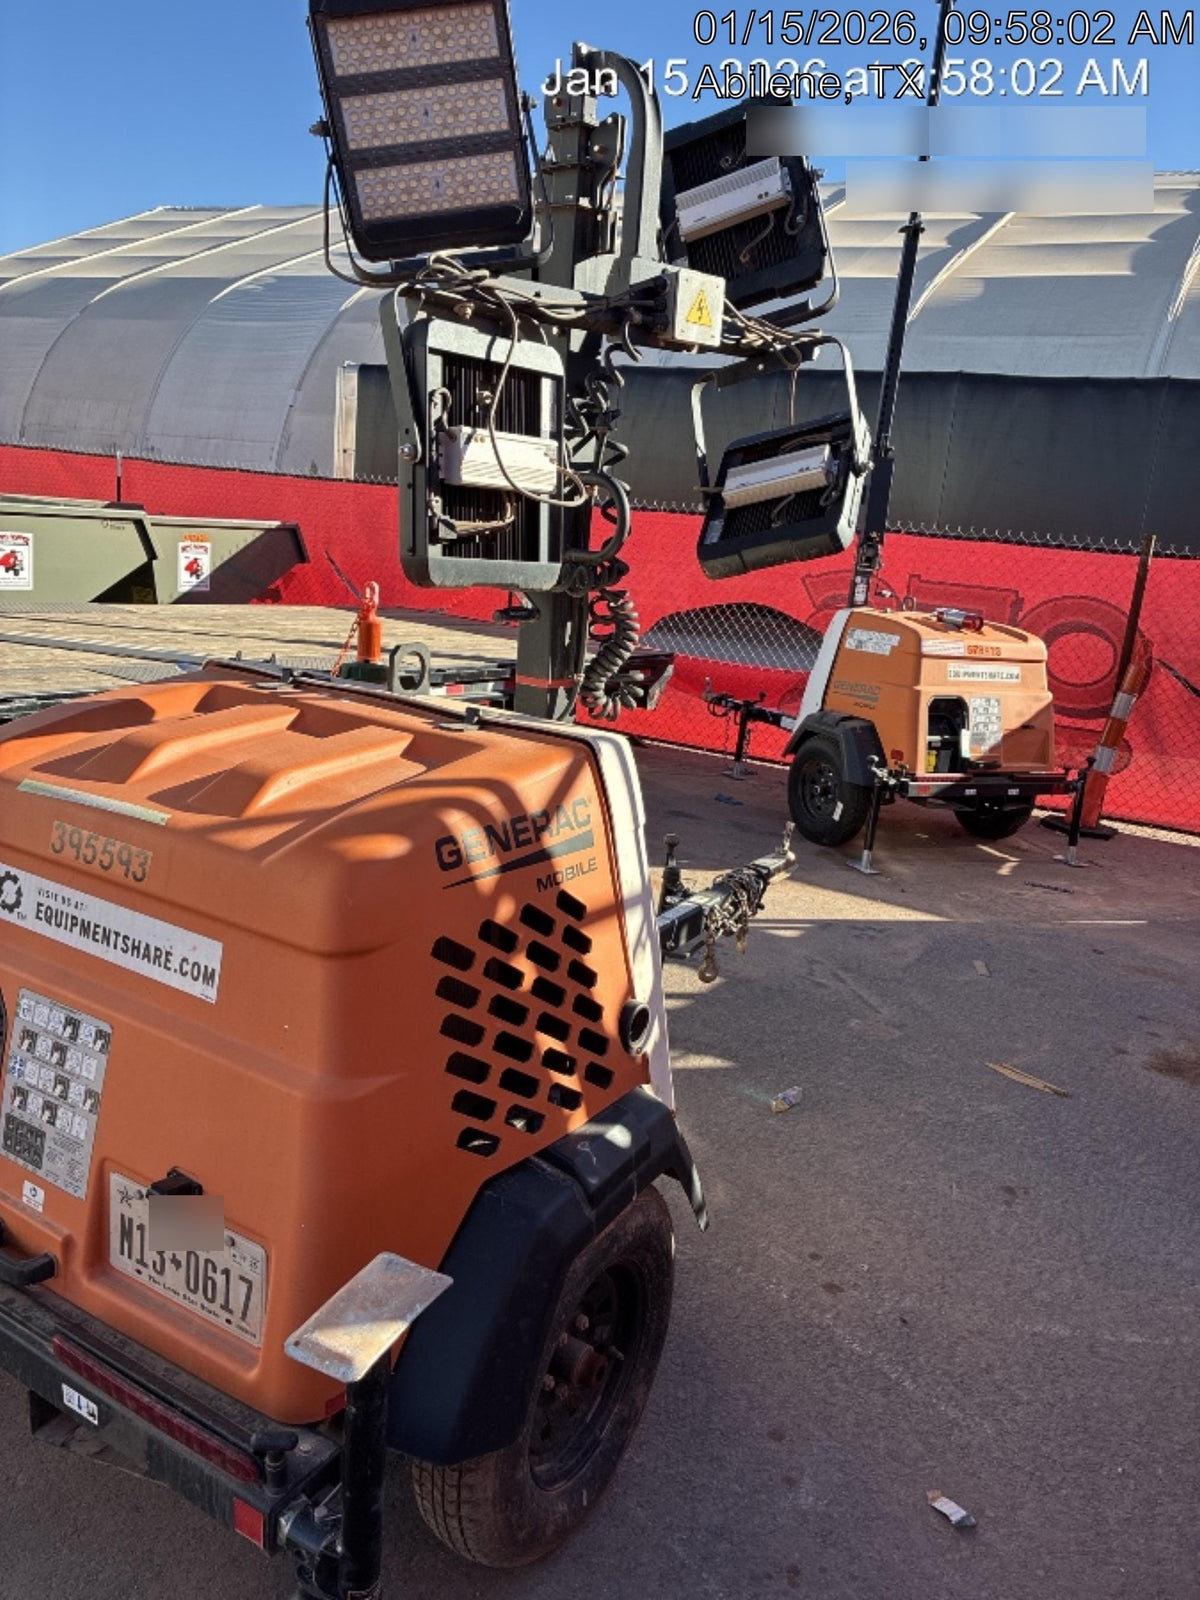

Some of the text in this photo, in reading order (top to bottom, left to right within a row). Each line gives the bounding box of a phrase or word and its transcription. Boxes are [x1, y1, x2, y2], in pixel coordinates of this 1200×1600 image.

[51, 821, 151, 883] 395593
[434, 797, 592, 872] GENERAC
[536, 858, 598, 892] MOBILE
[35, 901, 217, 989] EQUIPMENTSHARE.COM
